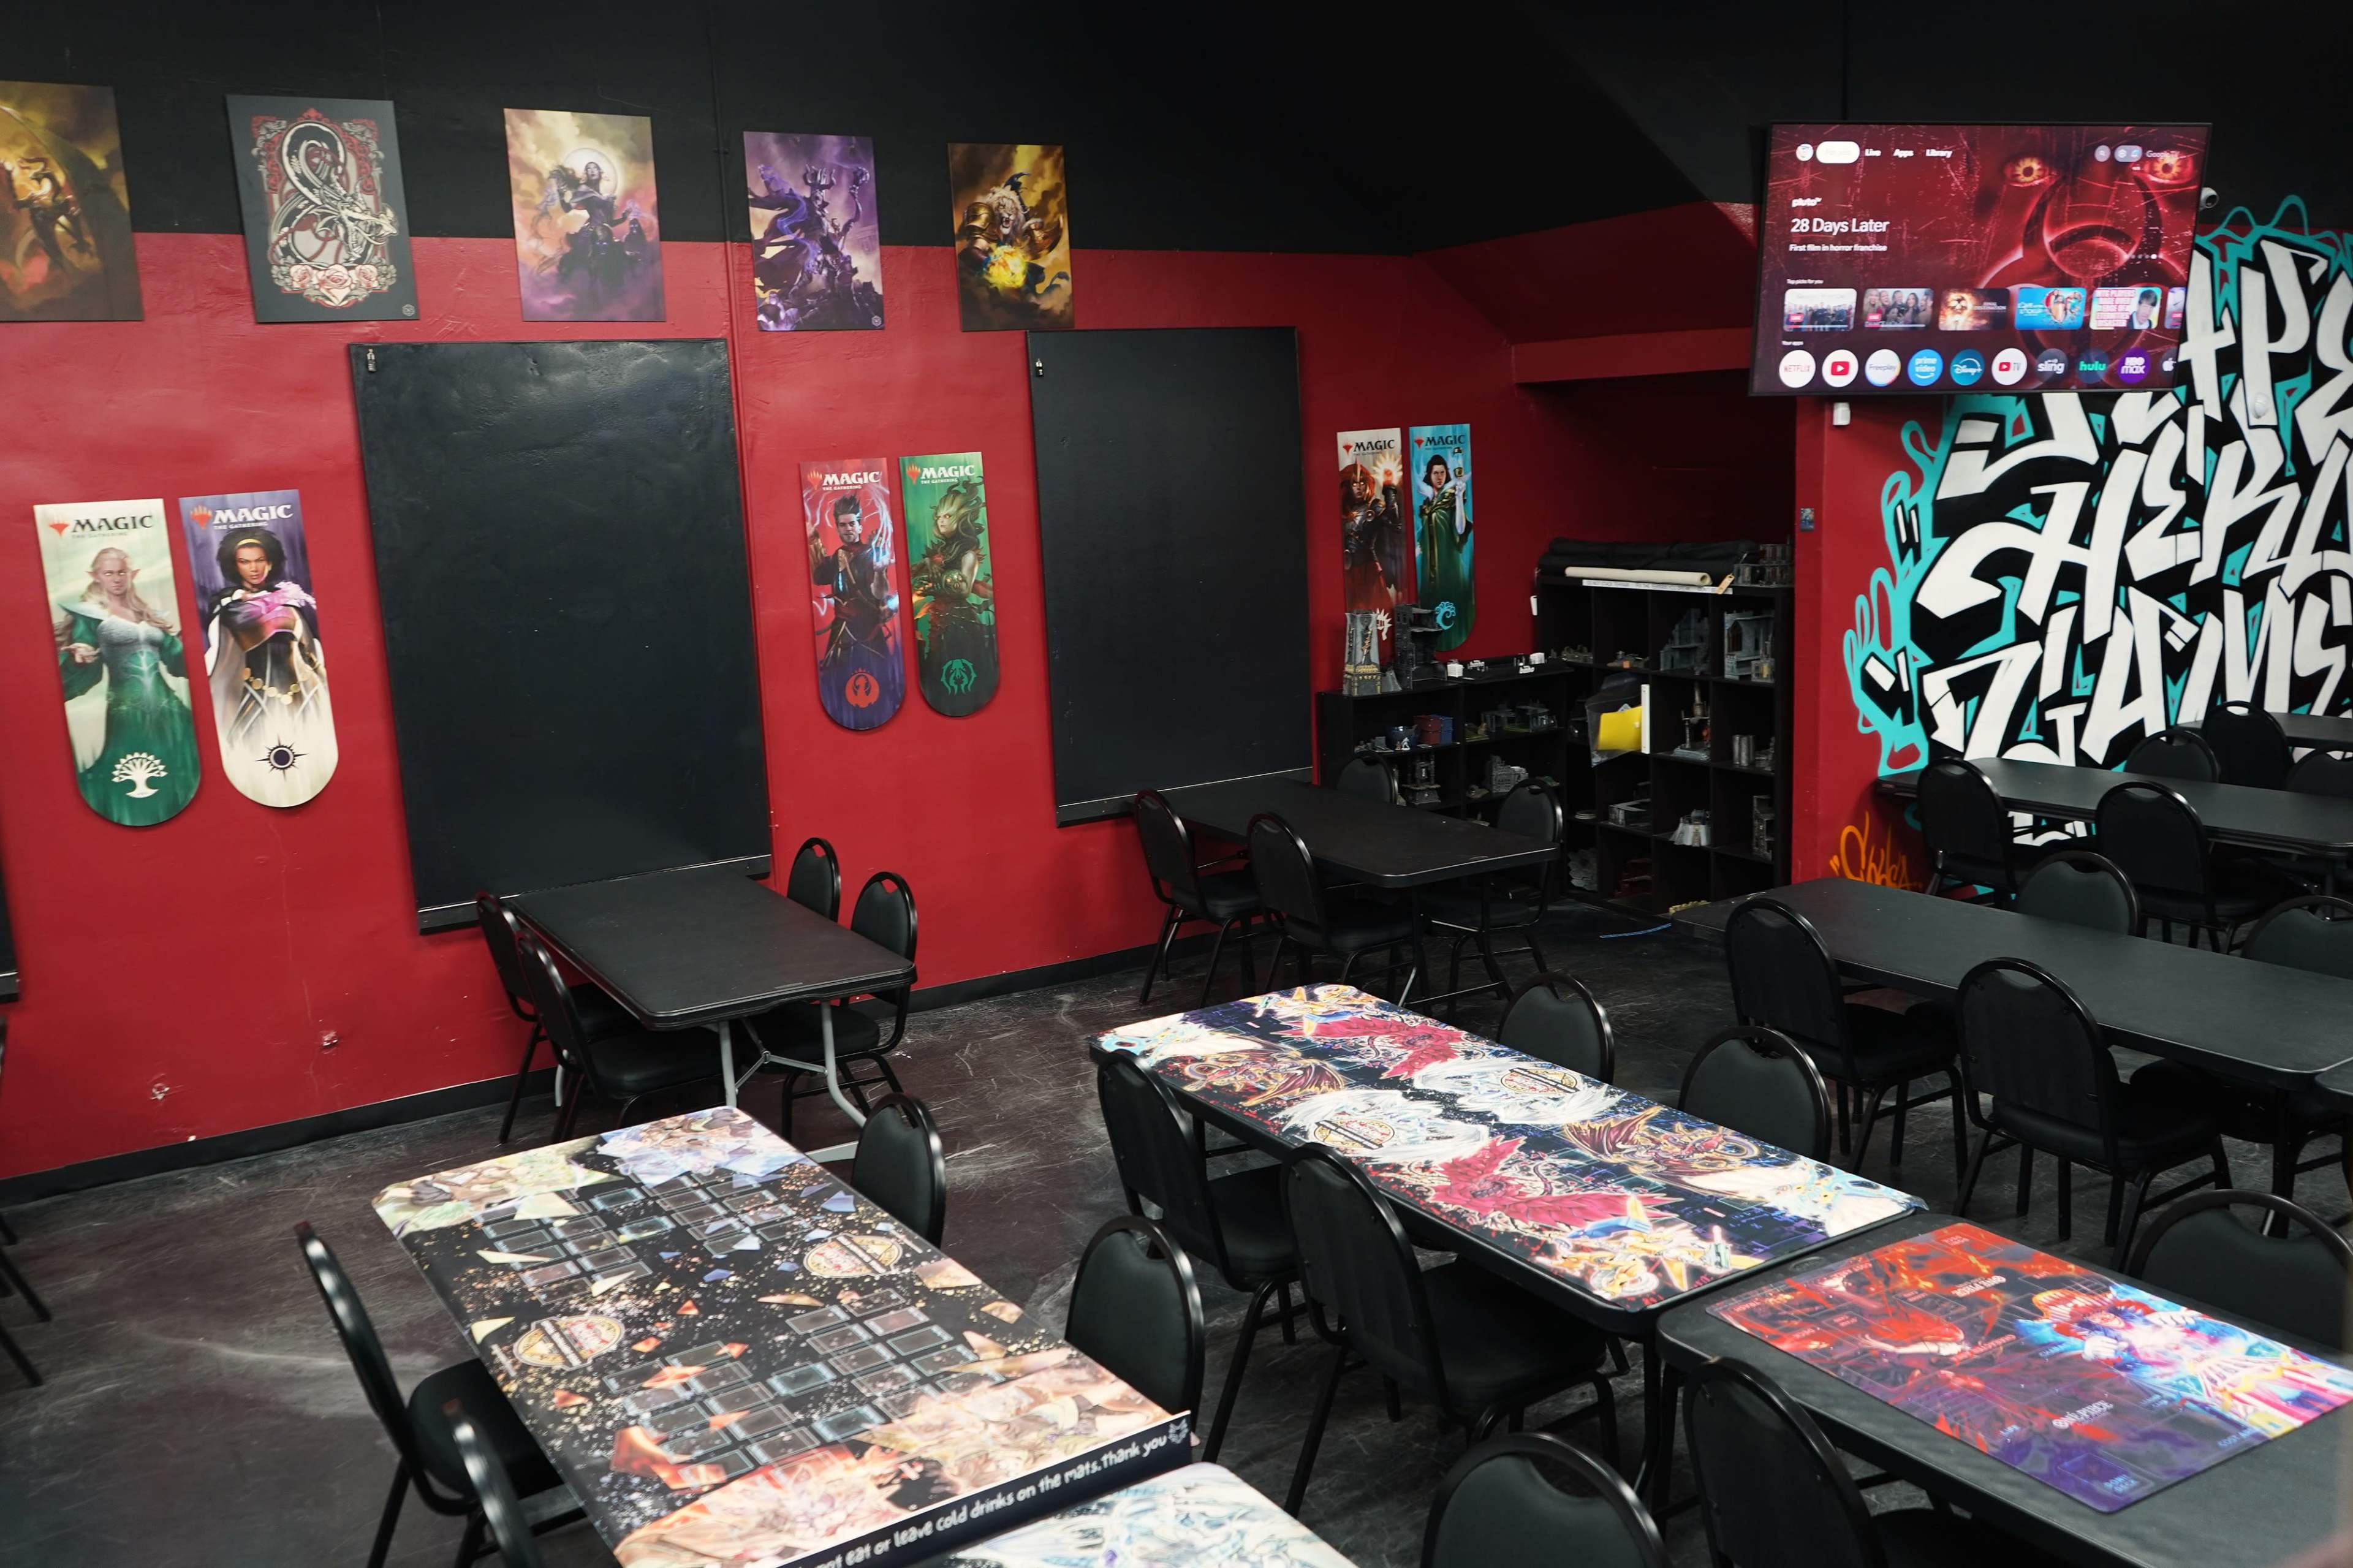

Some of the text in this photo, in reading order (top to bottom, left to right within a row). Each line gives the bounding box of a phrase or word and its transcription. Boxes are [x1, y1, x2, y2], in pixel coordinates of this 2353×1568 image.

[1893, 149, 1914, 157] Apps
[1926, 149, 1952, 159] Library
[1790, 218, 1890, 236] 28 Days Later
[1915, 357, 1937, 365] prime
[2037, 360, 2065, 374] sling
[2078, 360, 2106, 371] hulu
[1784, 364, 1811, 373] NETFLIX
[1353, 439, 1395, 452] MAGIC
[1425, 434, 1466, 446] MAGIC
[822, 471, 881, 486] MAGIC
[921, 464, 975, 480] MAGIC
[214, 504, 294, 525] MAGIC
[71, 515, 153, 533] MAGIC
[845, 1543, 871, 1566] eat
[873, 1539, 892, 1555] or
[894, 1521, 933, 1548] leave
[936, 1504, 968, 1531] cold
[970, 1491, 1015, 1519] drinks
[1016, 1485, 1037, 1501] on
[1038, 1473, 1062, 1493] the
[1142, 1435, 1168, 1458] you
